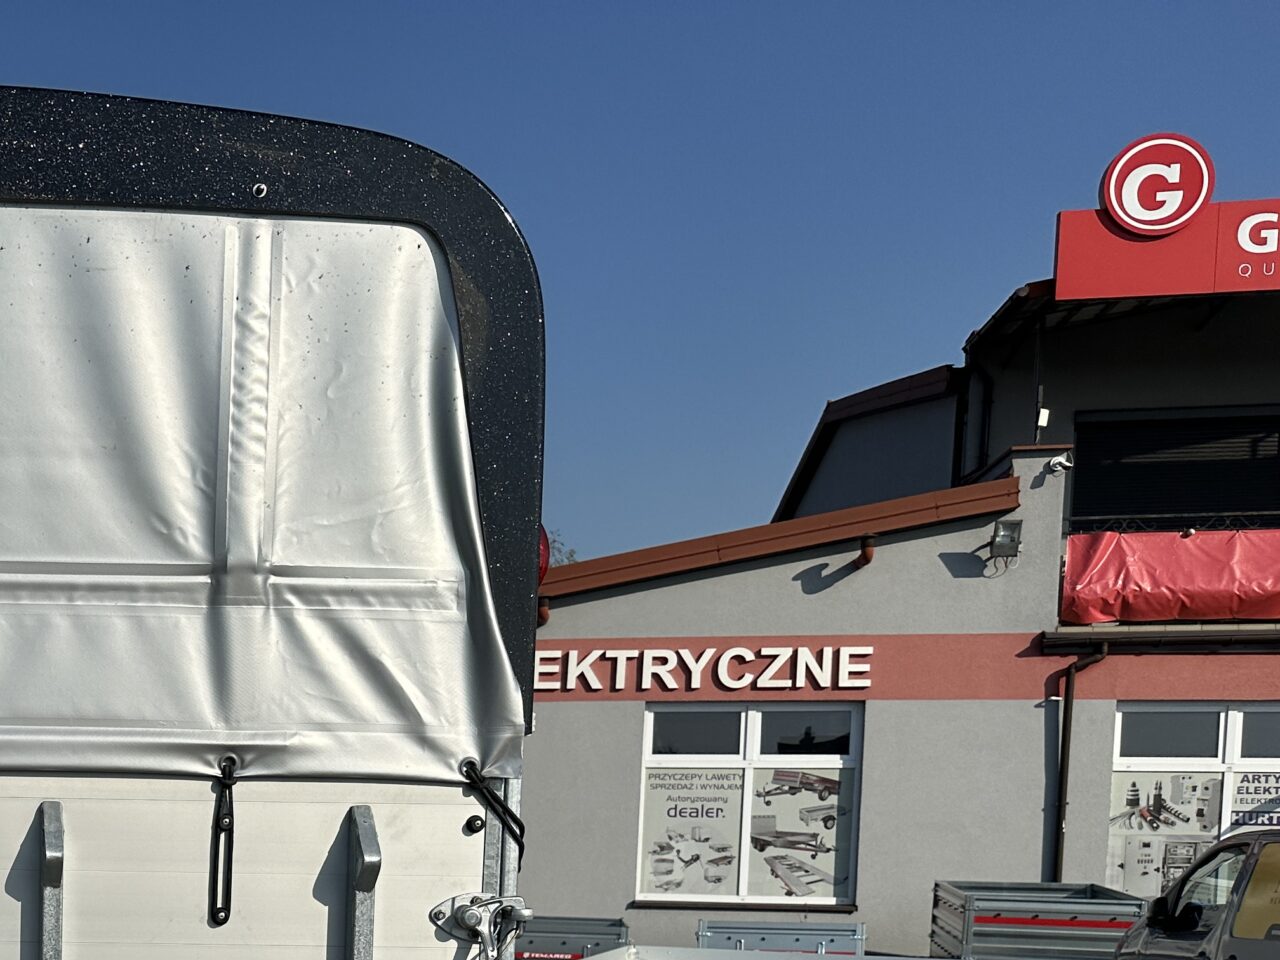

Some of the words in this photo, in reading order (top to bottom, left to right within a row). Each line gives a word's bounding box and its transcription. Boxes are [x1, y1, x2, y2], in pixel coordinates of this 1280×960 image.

[1121, 163, 1184, 221] G
[533, 646, 874, 690] EKTRYCZNE
[705, 773, 742, 781] LAWETY
[666, 795, 728, 803] Autoryzowany
